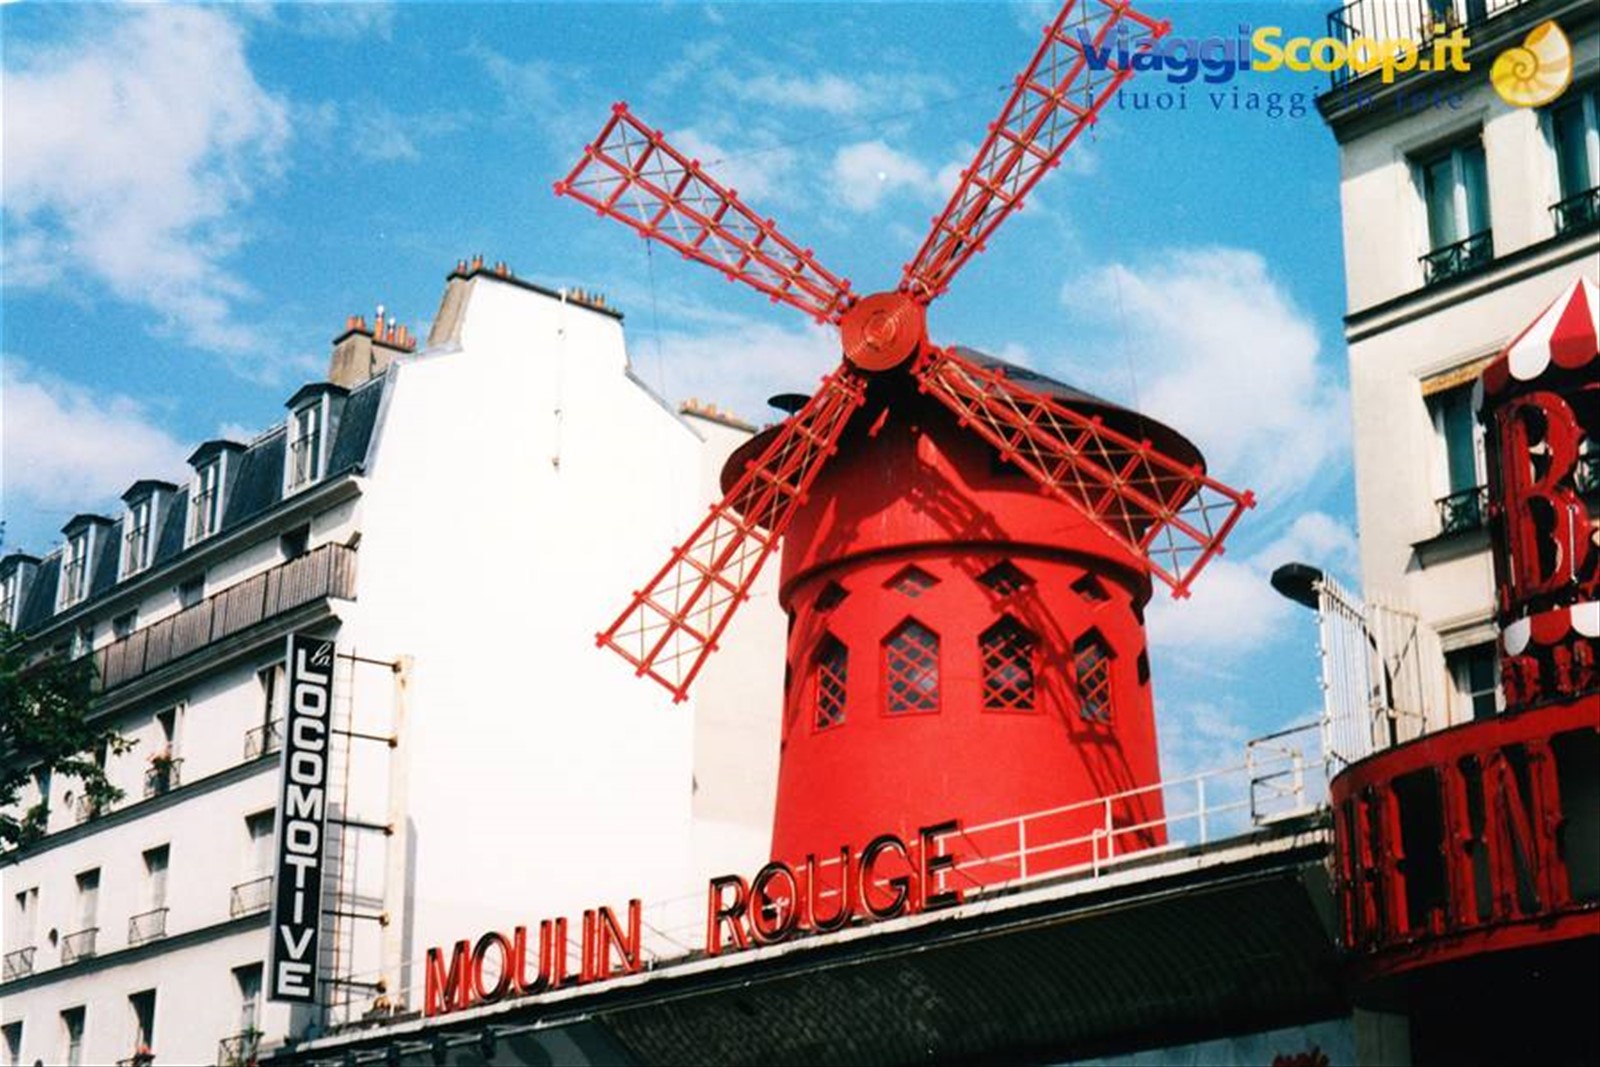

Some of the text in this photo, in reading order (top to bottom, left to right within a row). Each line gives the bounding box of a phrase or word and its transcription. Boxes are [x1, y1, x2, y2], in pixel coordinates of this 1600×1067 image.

[277, 648, 328, 997] LOCOMOTIVE
[424, 818, 964, 1018] MOULIN ROUGE
